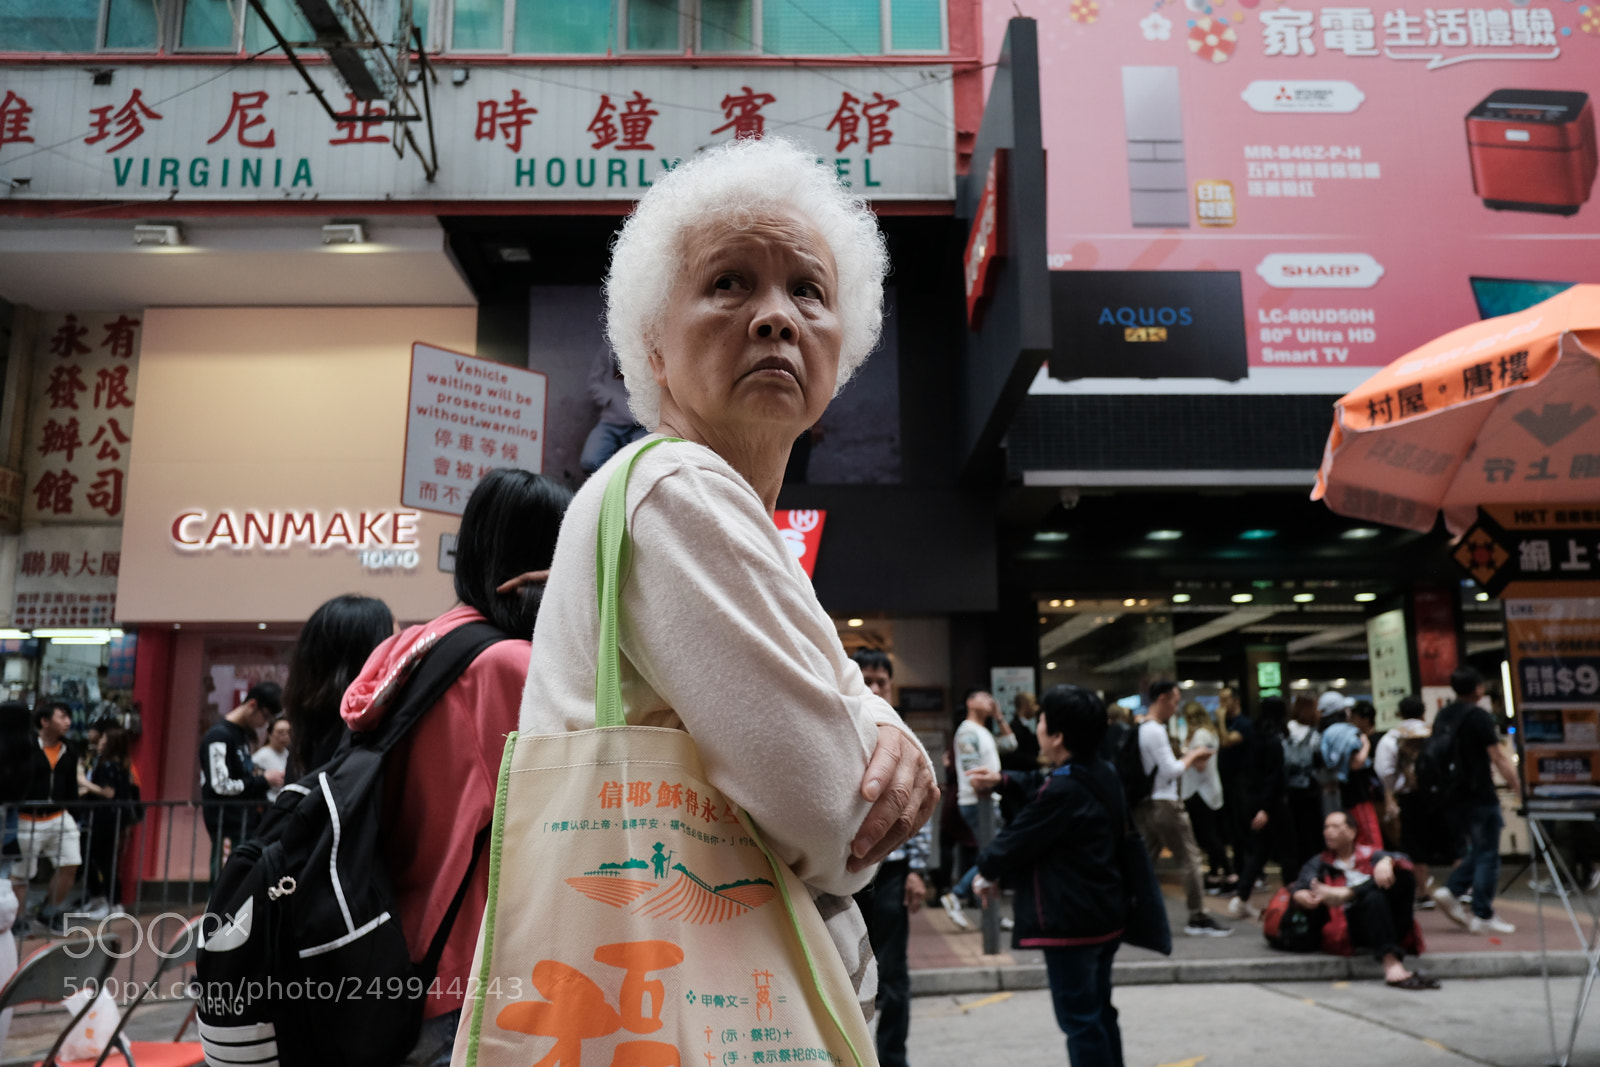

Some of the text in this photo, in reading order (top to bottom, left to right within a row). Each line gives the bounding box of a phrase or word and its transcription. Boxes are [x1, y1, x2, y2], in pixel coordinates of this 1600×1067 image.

[1259, 7, 1558, 57] 家電生活體驗
[113, 156, 314, 188] VIRGINIA
[1281, 266, 1361, 280] SHARP
[1098, 306, 1194, 327] AQUOS
[1297, 328, 1345, 345] Ultra
[1348, 329, 1377, 344] HD
[1261, 347, 1350, 363] Smart TV
[454, 359, 509, 384] Vehicle
[426, 372, 533, 406] waiting will be
[85, 314, 142, 518] 有限公司
[436, 392, 521, 420] prosecuted
[416, 404, 539, 442] without warning
[434, 427, 520, 463] 停車等候
[419, 480, 474, 505] 而不
[171, 511, 418, 546] CANMAKE
[1518, 538, 1600, 572] 網上
[208, 996, 245, 1016] PENG
